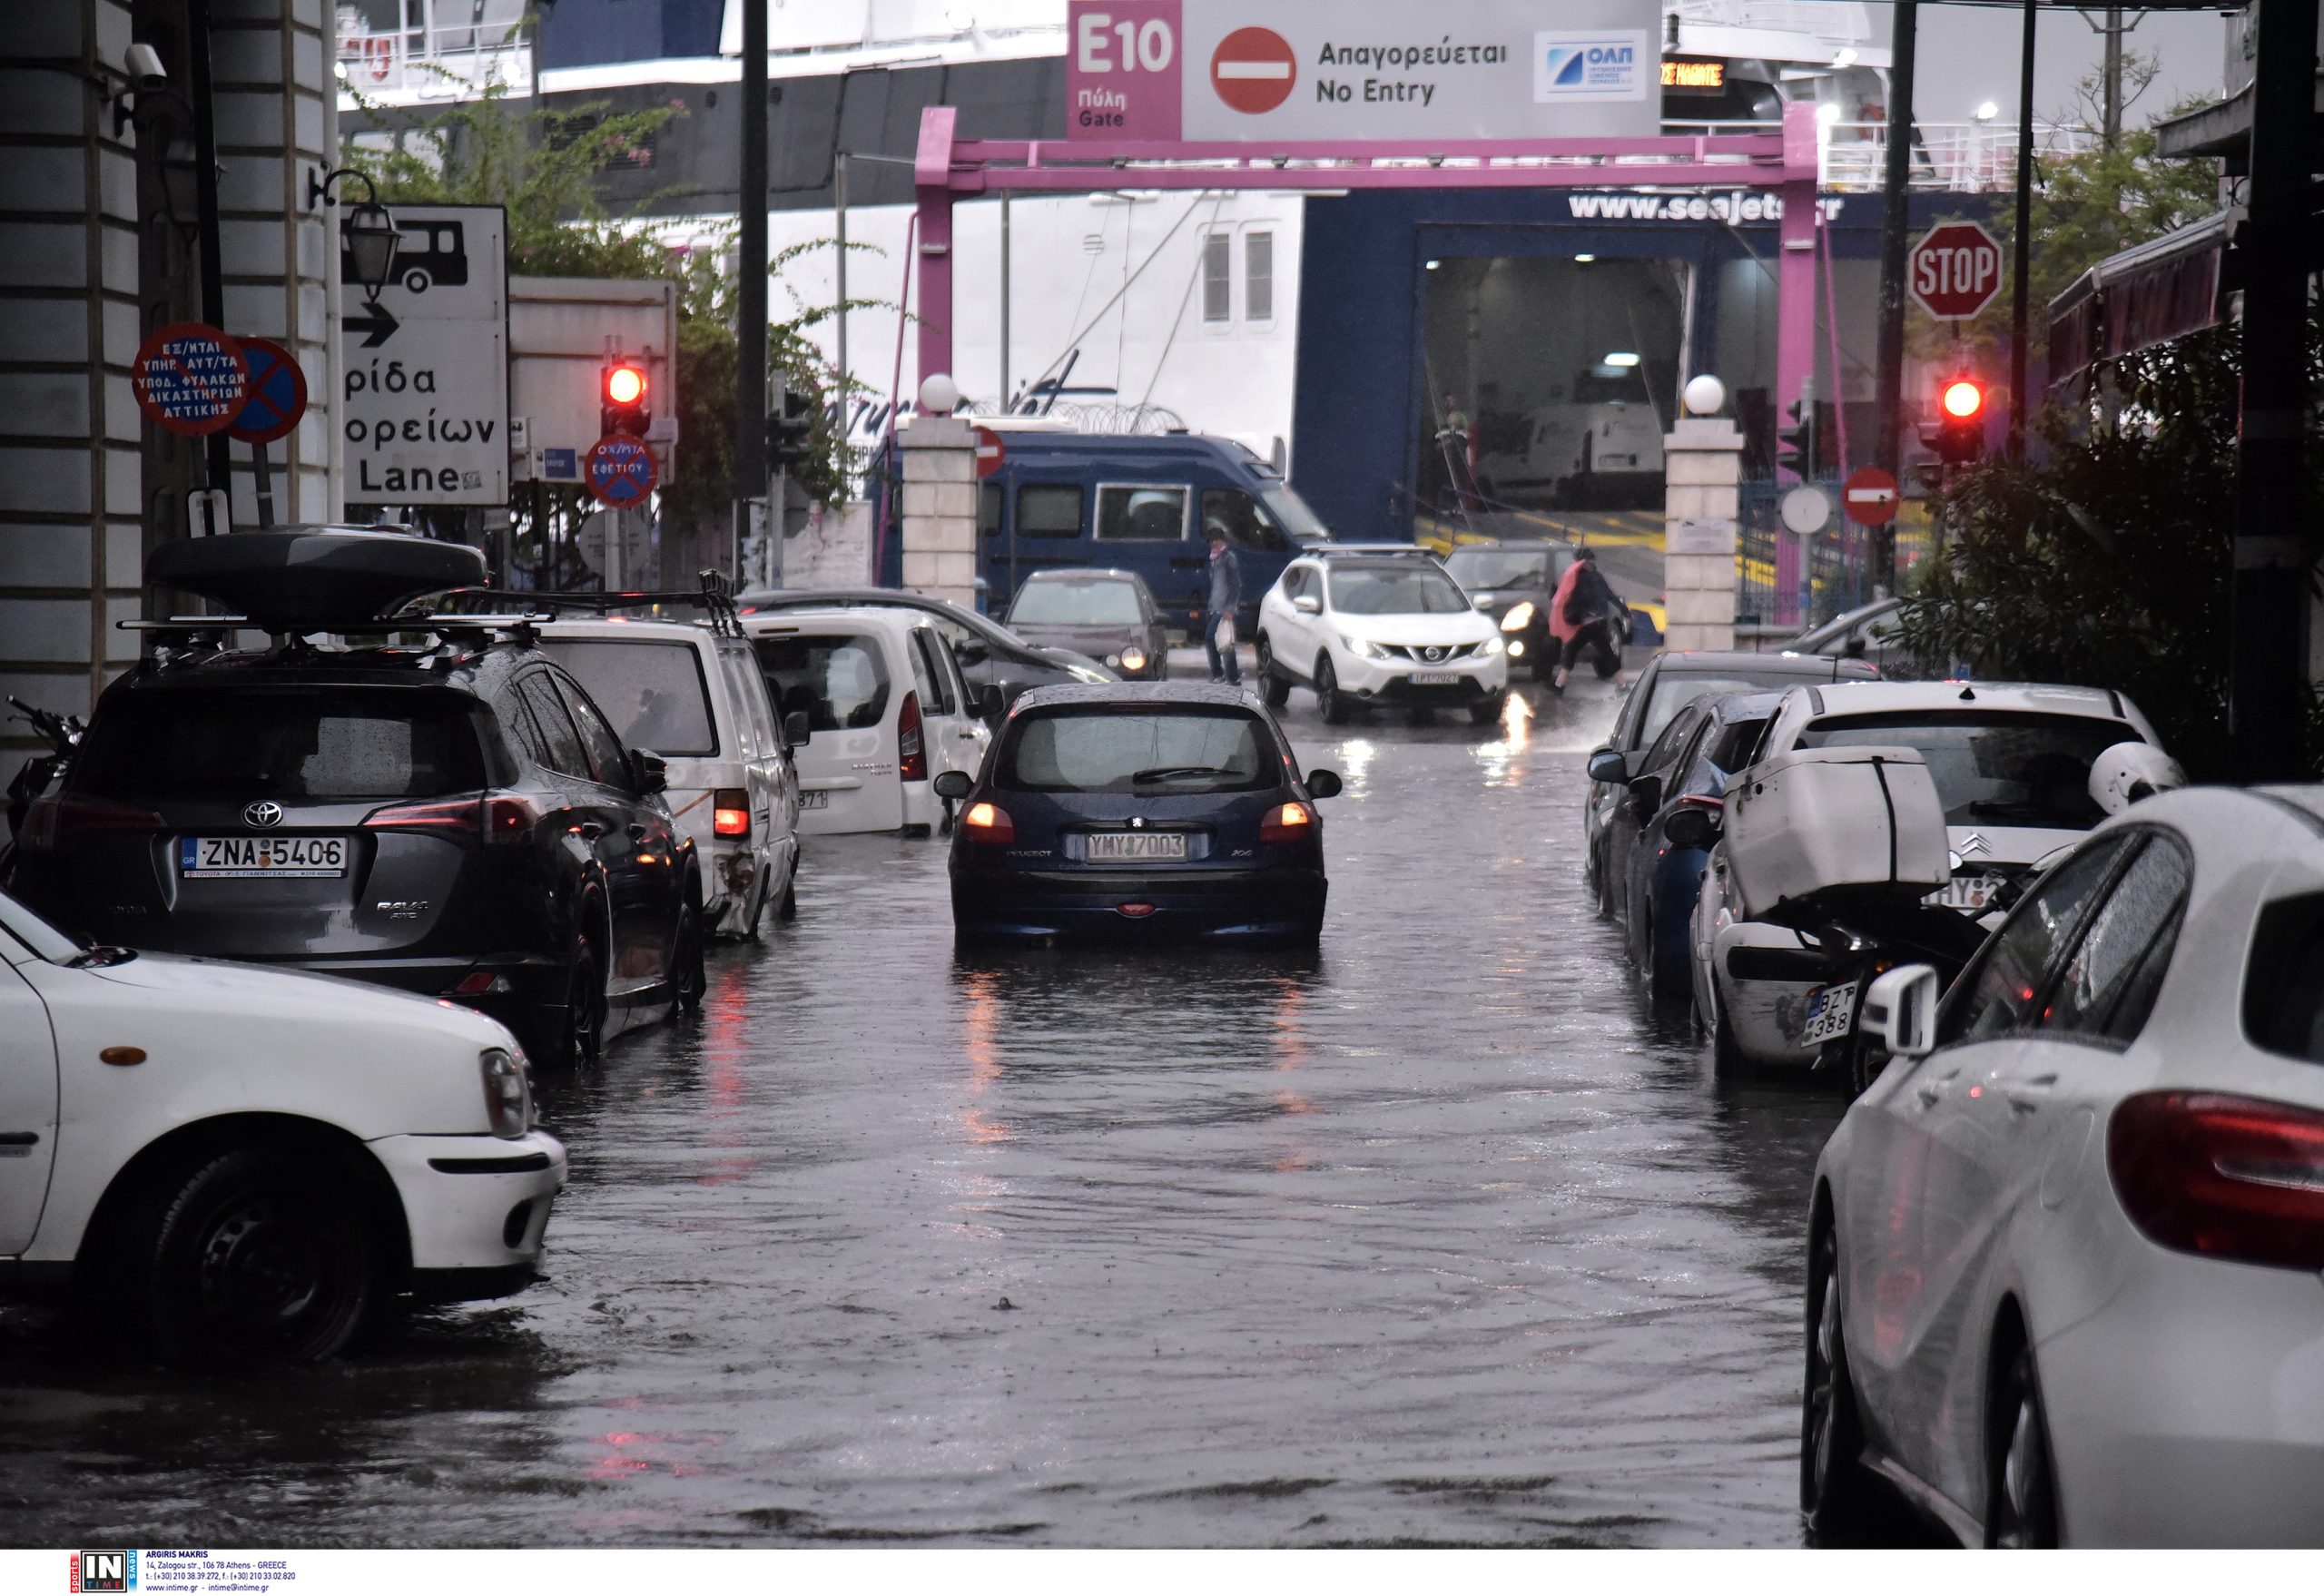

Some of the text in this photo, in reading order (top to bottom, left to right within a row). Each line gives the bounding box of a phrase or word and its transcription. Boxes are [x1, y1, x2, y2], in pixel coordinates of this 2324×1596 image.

[1078, 14, 1173, 73] E10
[1317, 35, 1507, 71] Απαγορεύεται
[1078, 87, 1126, 112] Πύλη
[1316, 78, 1435, 107] No Entry
[1078, 110, 1124, 127] Gate
[1917, 246, 1994, 295] STOP
[187, 356, 238, 370] ΑΥΤ/ΤΑ
[138, 373, 245, 389] ΥΠΟΔ. ΦΥΛΑΚΩΝ
[345, 358, 436, 401] ρίδα
[148, 387, 242, 403] ΔΙΚΑΣΤΗΡΙΩΝ
[164, 403, 229, 419] ΑΤΤΙΚΗΣ
[345, 408, 495, 451] ορείων
[359, 459, 459, 492] Lane
[1815, 1012, 1847, 1037] 388
